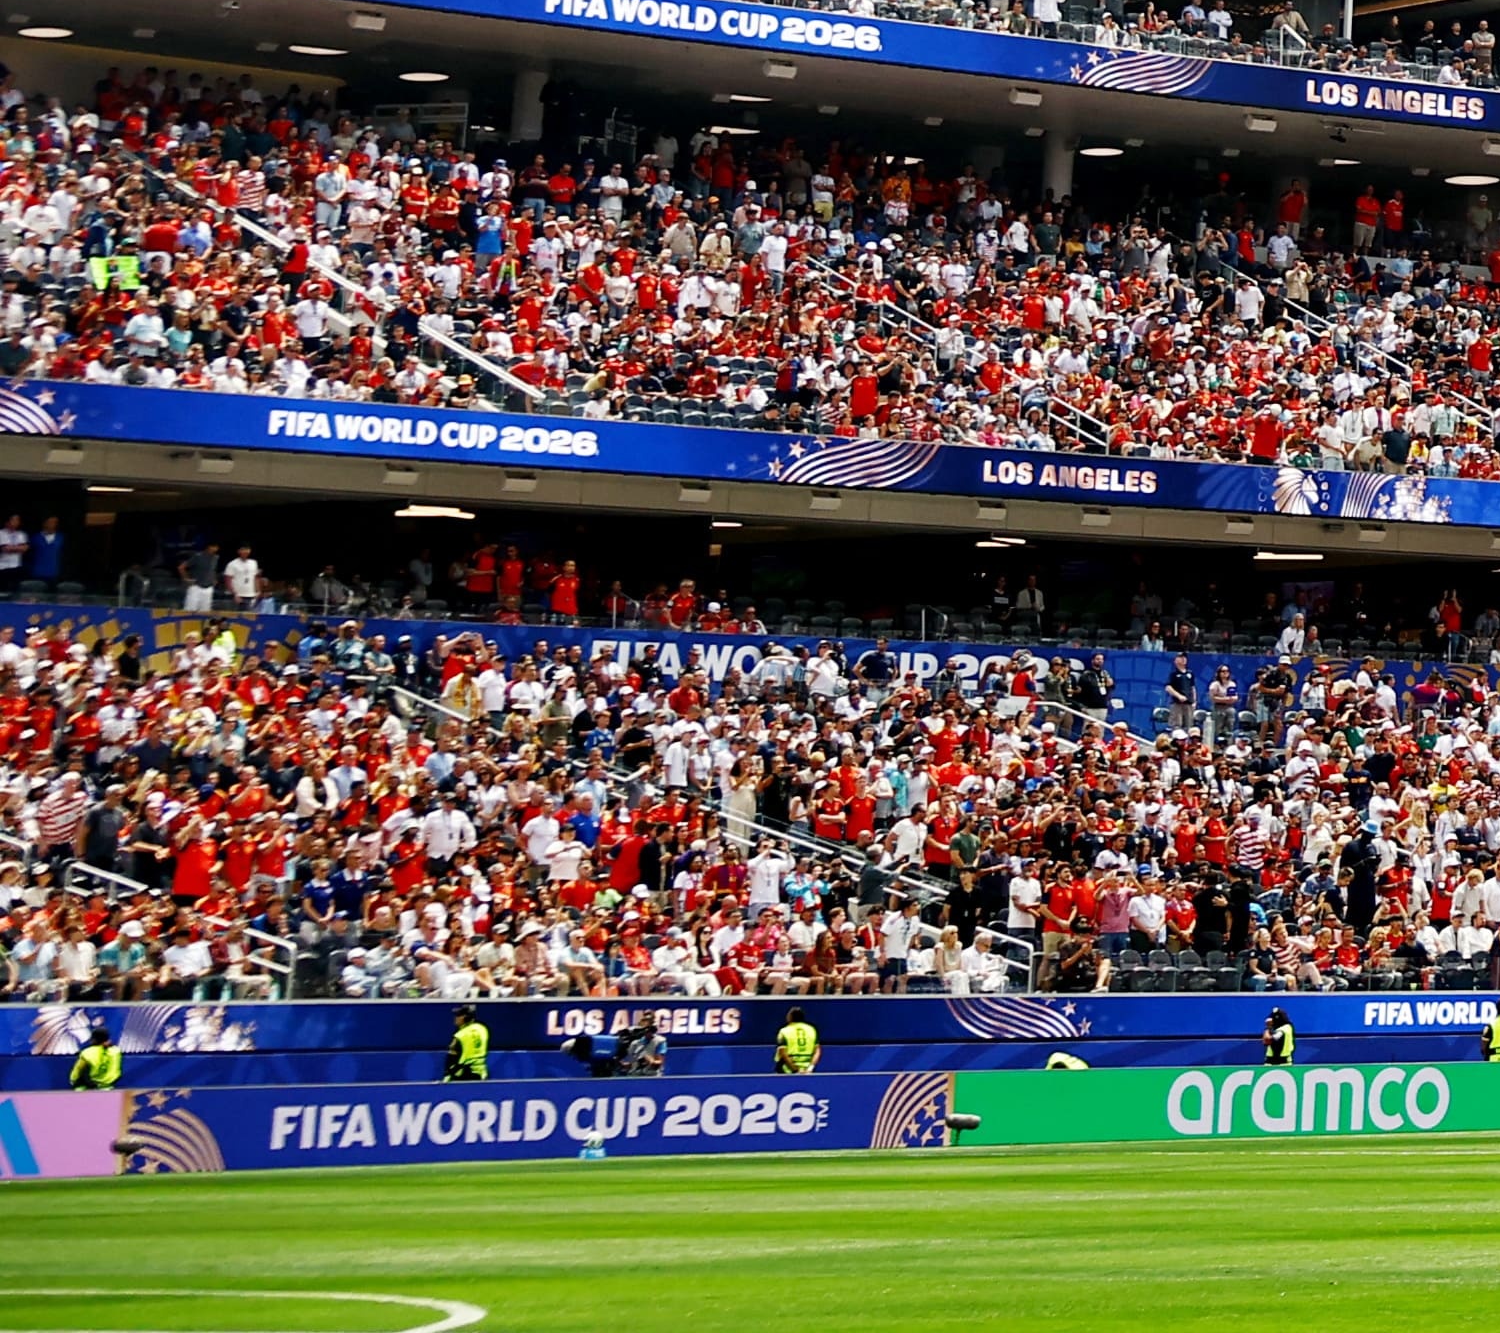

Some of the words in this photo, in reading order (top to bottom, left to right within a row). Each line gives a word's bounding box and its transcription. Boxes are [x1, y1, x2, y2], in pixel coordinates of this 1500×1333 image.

[720, 10, 778, 38] CUP
[780, 17, 881, 52] 2026
[1307, 80, 1357, 106] LOS
[1365, 87, 1483, 119] ANGELES
[268, 410, 331, 438] FIFA
[335, 415, 438, 445] WORLD
[440, 422, 497, 448] CUP
[499, 426, 598, 456] 2026
[984, 460, 1032, 485] LOS
[1039, 465, 1156, 493] ANGELES
[547, 1009, 604, 1035] LOS
[1364, 1002, 1415, 1025] FIFA
[1416, 1001, 1498, 1024] WORLD
[1167, 1066, 1450, 1134] aramco
[269, 1103, 376, 1149] FIFA
[385, 1099, 557, 1146] WORLD
[565, 1097, 656, 1141] CUP
[663, 1092, 816, 1136] 2026
